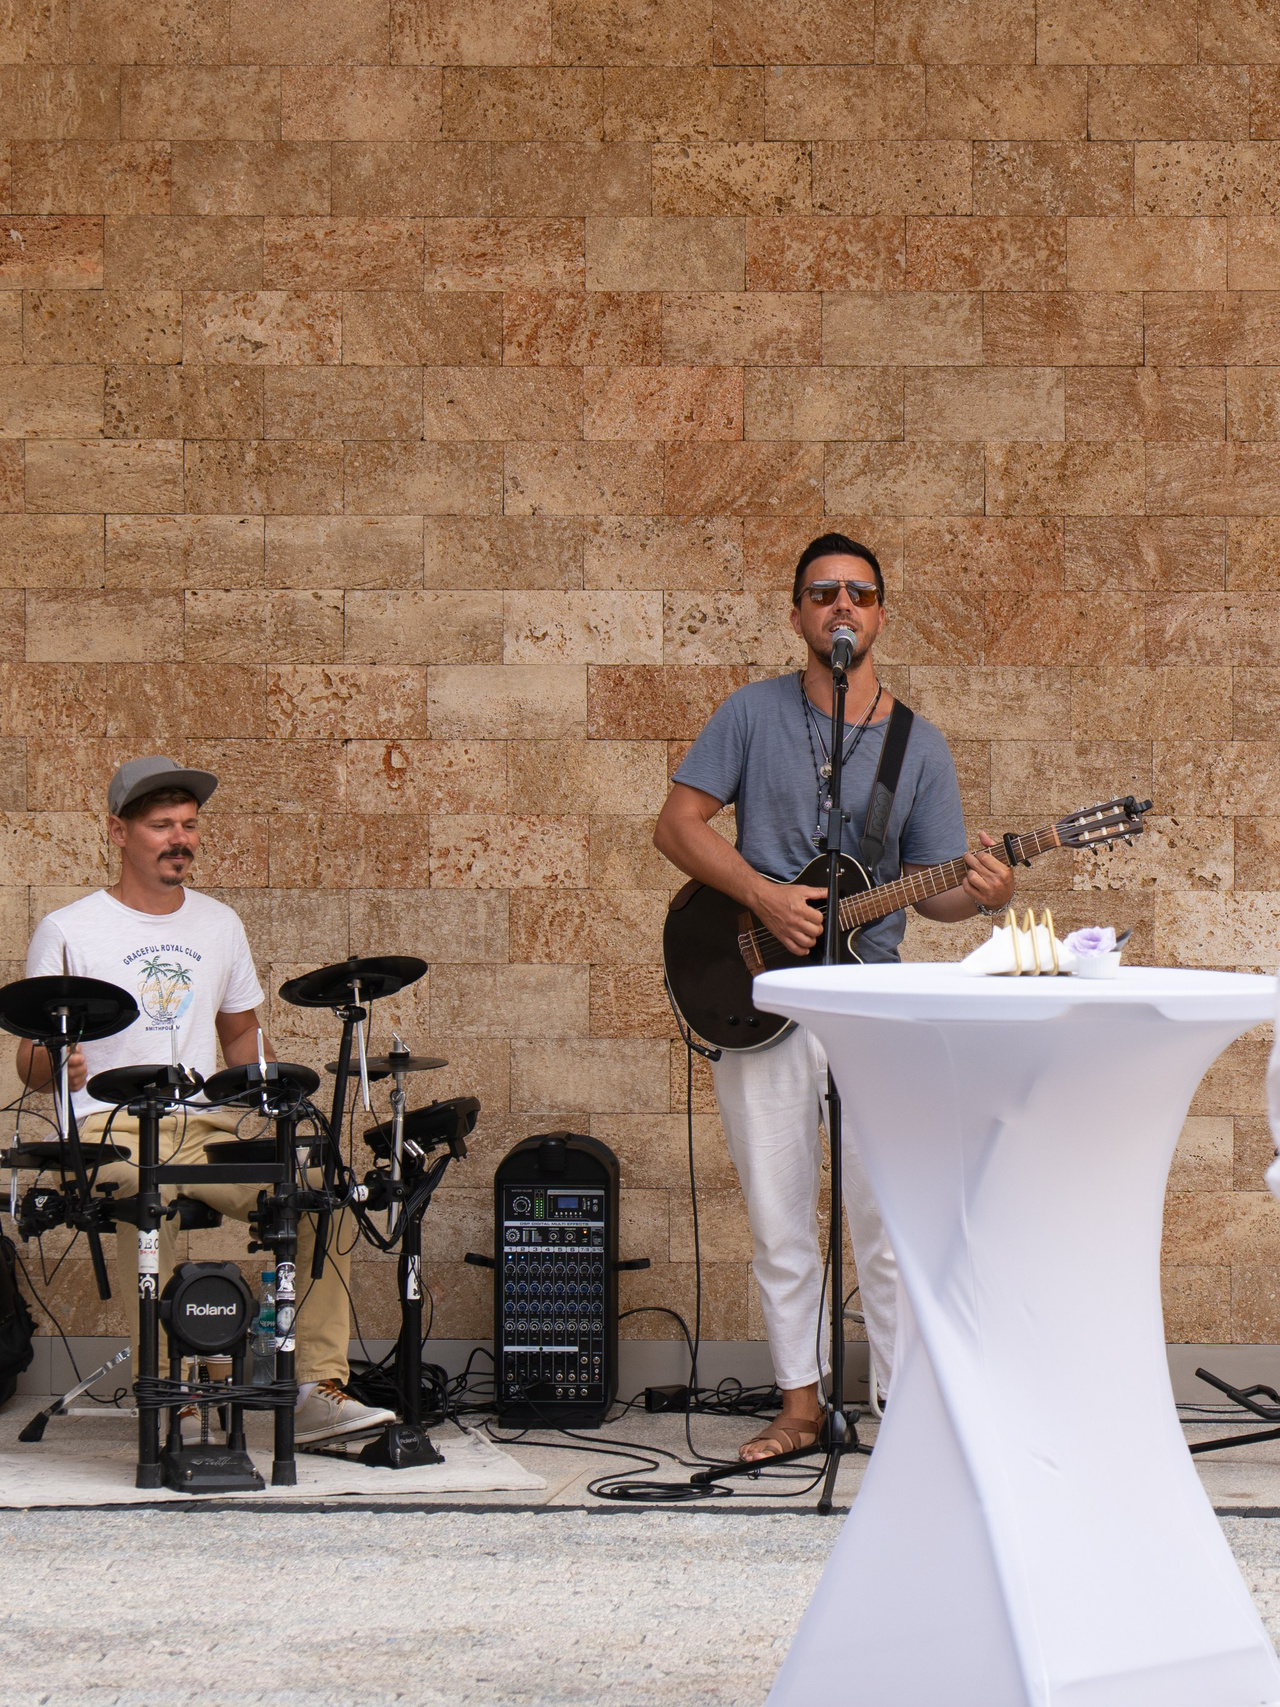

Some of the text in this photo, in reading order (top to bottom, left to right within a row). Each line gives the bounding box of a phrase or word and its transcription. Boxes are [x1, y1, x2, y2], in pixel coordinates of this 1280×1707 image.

[123, 944, 202, 966] GRACEFUL ROYAL CLUB
[186, 1303, 237, 1316] Roland
